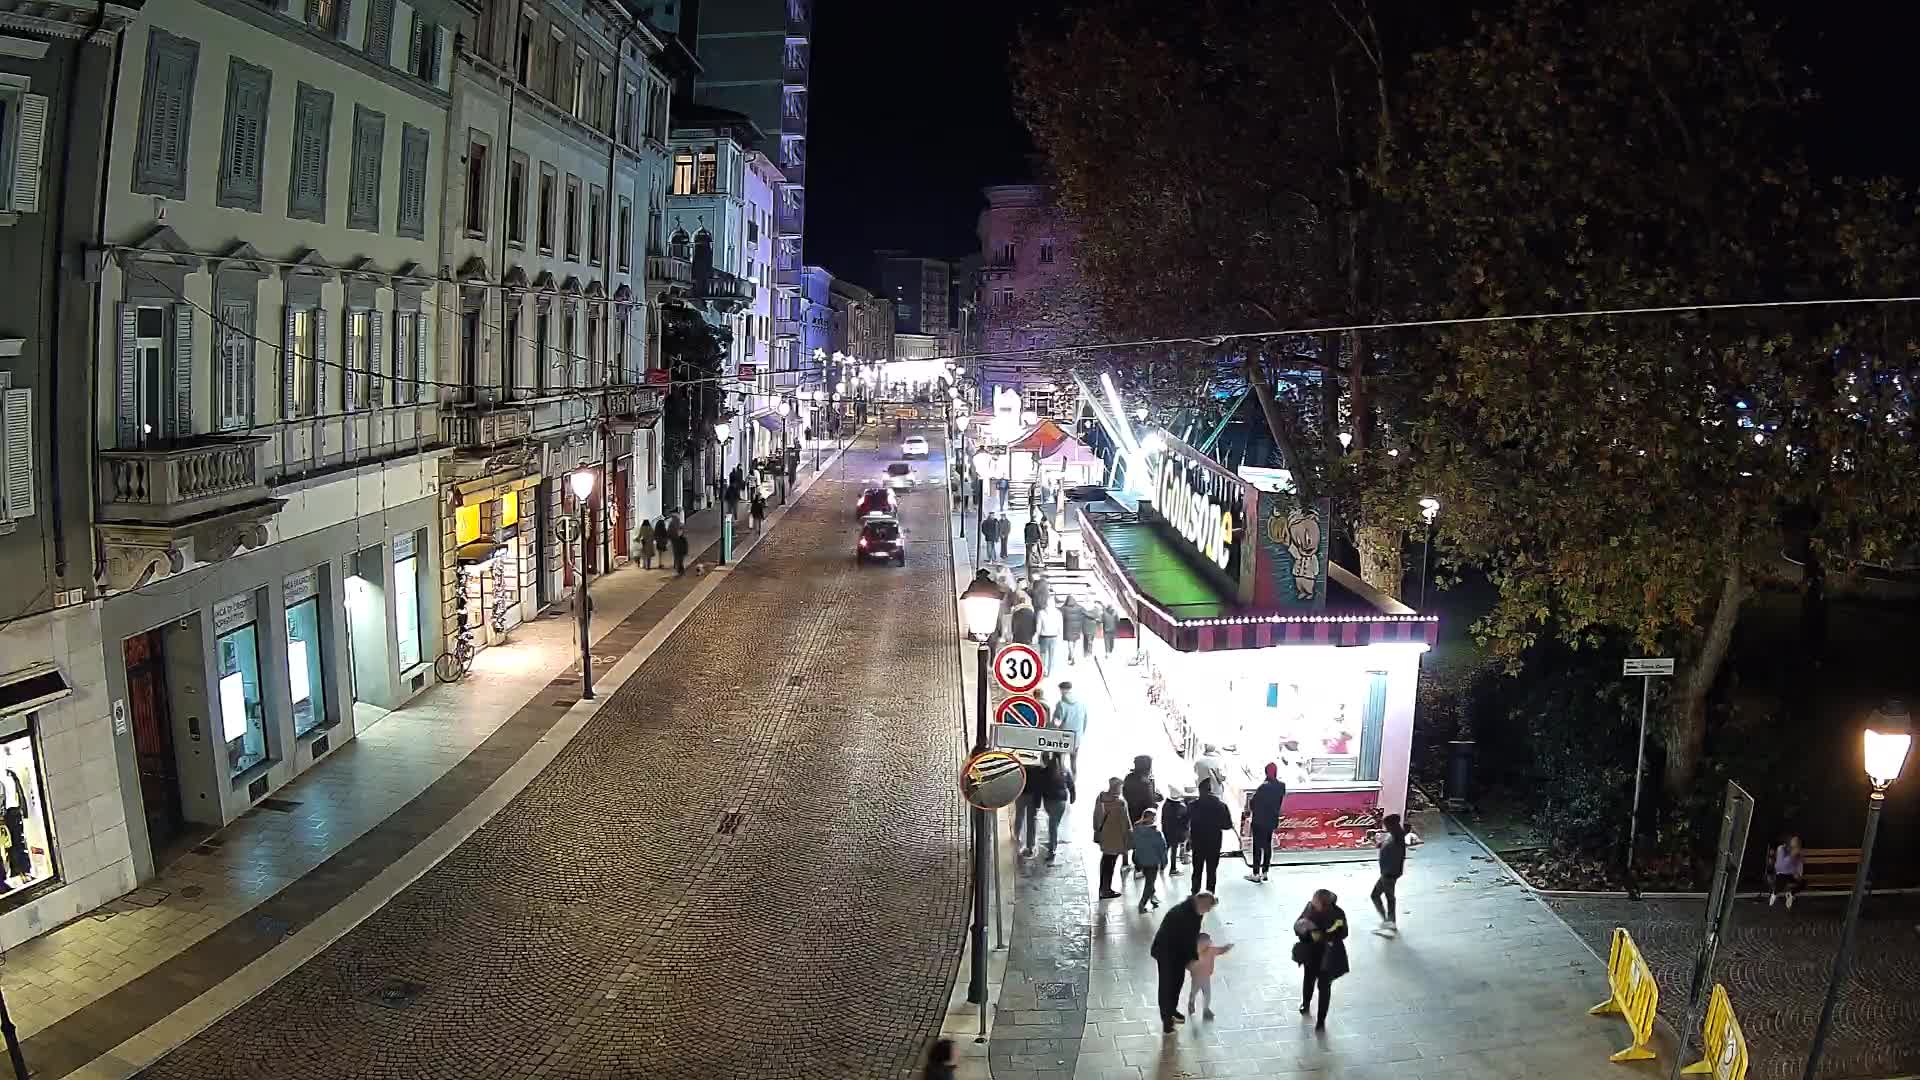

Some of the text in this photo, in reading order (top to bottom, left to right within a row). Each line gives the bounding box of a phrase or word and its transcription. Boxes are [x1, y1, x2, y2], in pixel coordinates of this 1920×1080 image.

[1161, 459, 1233, 570] Golosone
[1006, 658, 1033, 680] 30
[1038, 737, 1070, 749] Dante
